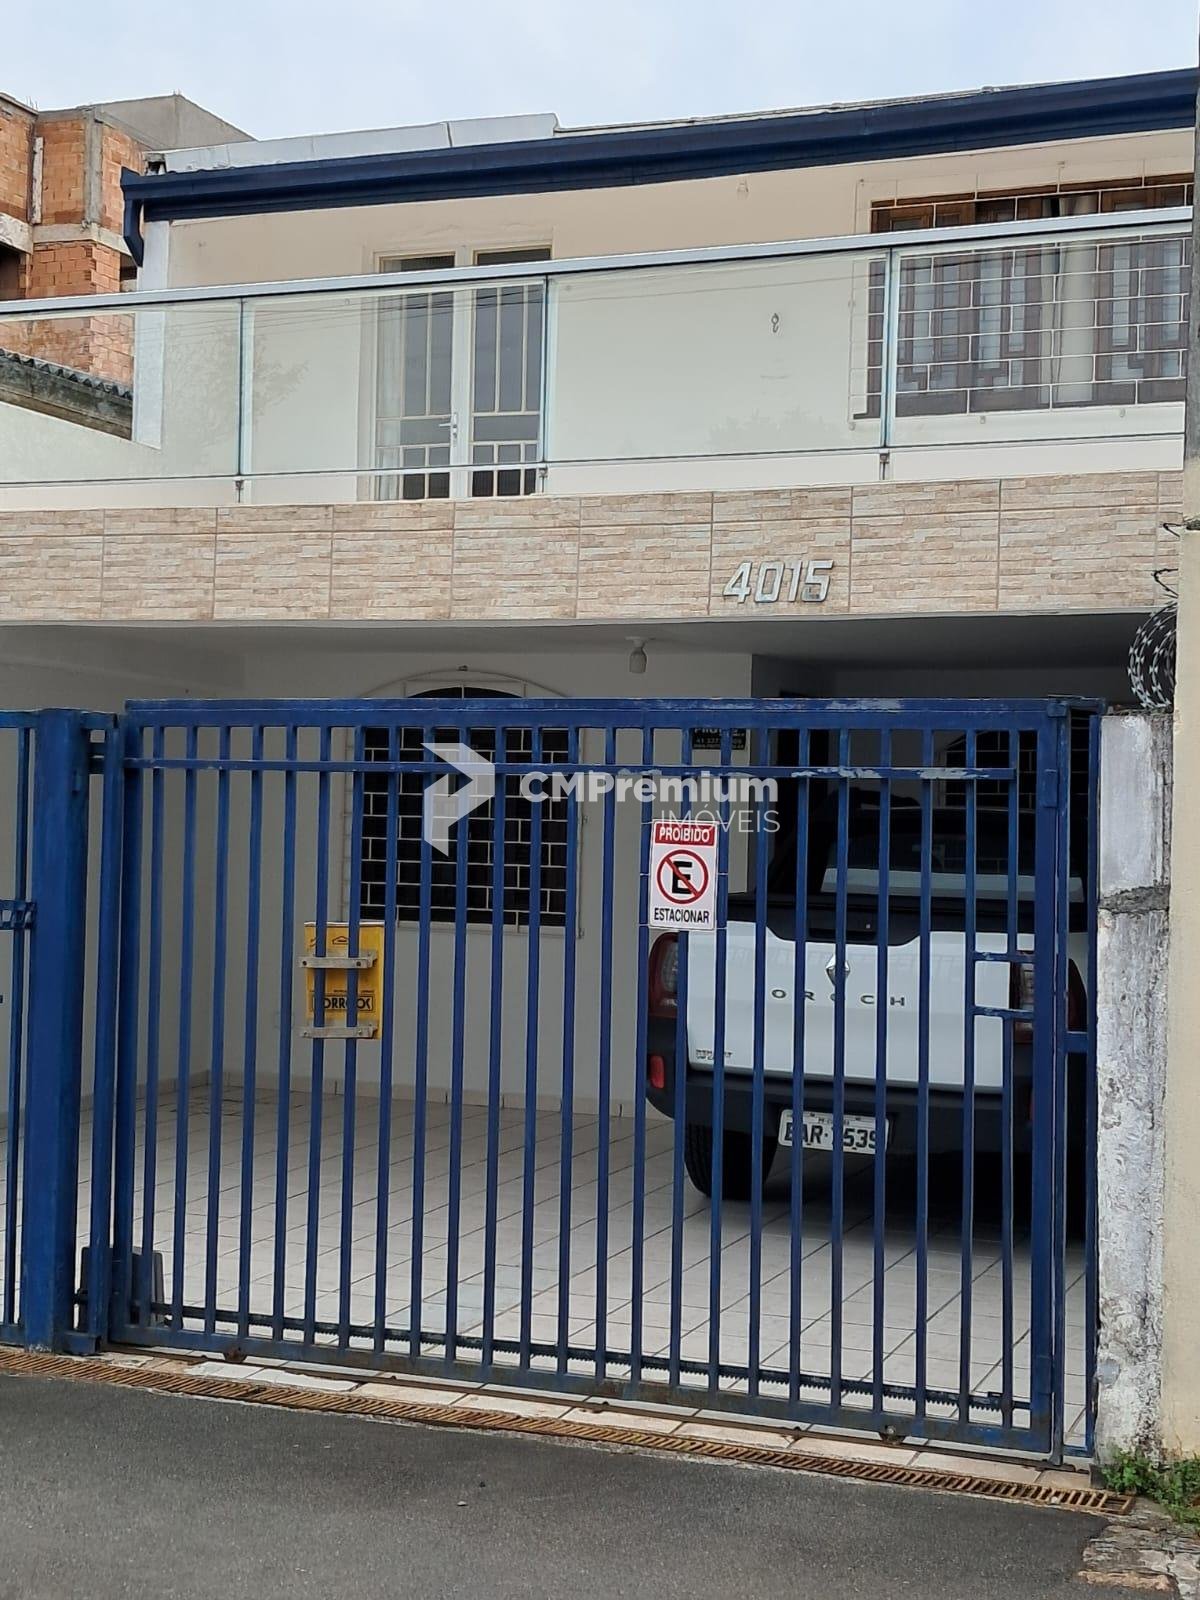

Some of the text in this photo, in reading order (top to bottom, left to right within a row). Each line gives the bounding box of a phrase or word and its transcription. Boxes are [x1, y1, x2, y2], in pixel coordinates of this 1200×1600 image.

[722, 558, 834, 603] 4015
[659, 826, 710, 843] PROIBIDO
[672, 860, 693, 894] E
[654, 907, 710, 924] ESTACIONAR
[318, 997, 371, 1009] ORROS
